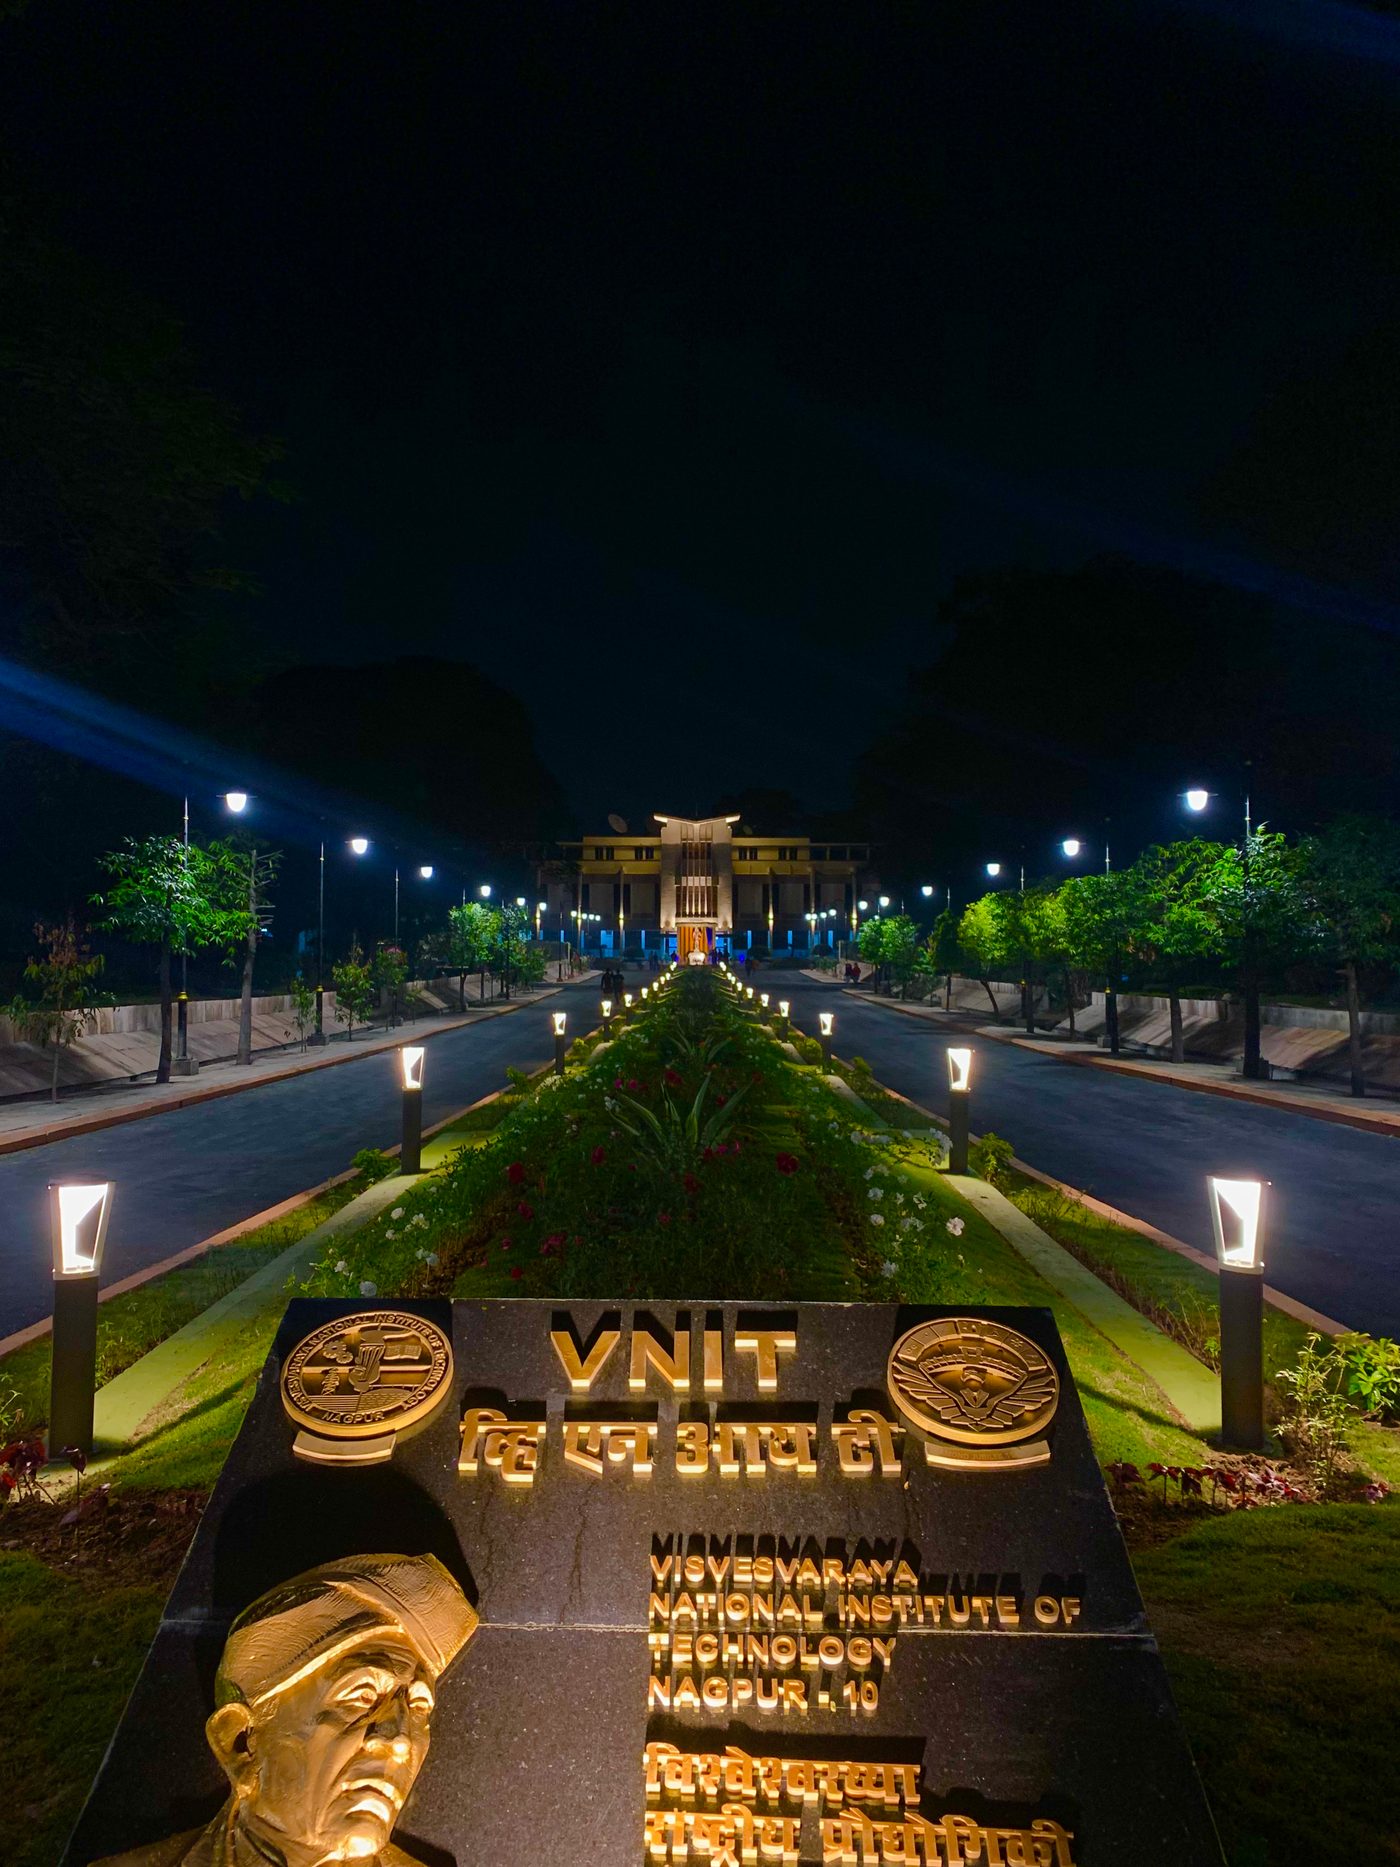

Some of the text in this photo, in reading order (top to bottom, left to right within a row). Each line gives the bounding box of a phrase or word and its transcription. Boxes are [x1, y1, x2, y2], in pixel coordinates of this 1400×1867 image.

[311, 1315, 370, 1347] NATIONAL
[373, 1313, 432, 1336] INSTITUTE
[427, 1331, 443, 1348] OF
[550, 1330, 796, 1388] VNIT
[321, 1410, 385, 1424] NAGPUR
[650, 1555, 918, 1585] VISVESVARAYA
[649, 1592, 1080, 1624] NATIONAL INSTITUTE OF
[648, 1633, 897, 1666] TECHNOLOGY
[648, 1675, 808, 1710] NAGPUR
[843, 1680, 879, 1711] 10
